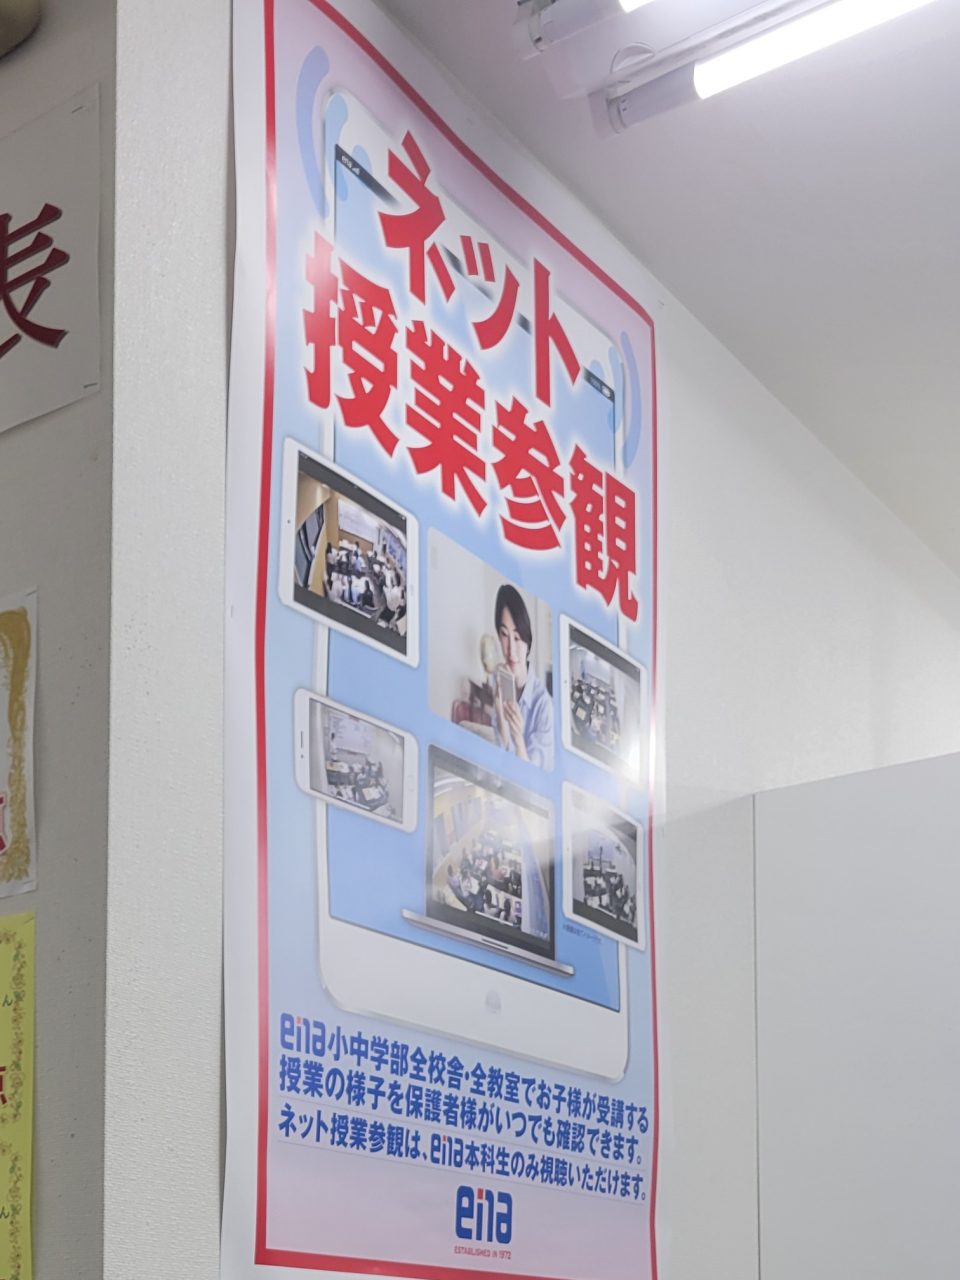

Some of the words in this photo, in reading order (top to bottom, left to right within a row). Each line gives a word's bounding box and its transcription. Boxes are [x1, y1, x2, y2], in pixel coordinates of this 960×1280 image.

[377, 130, 582, 407] ネット
[302, 230, 638, 622] 授業参観
[279, 1054, 642, 1165] 授業の様子を保護者様がいつでも確認できます。
[454, 1246, 490, 1257] ESTABLISHED
[455, 1185, 512, 1245] ena
